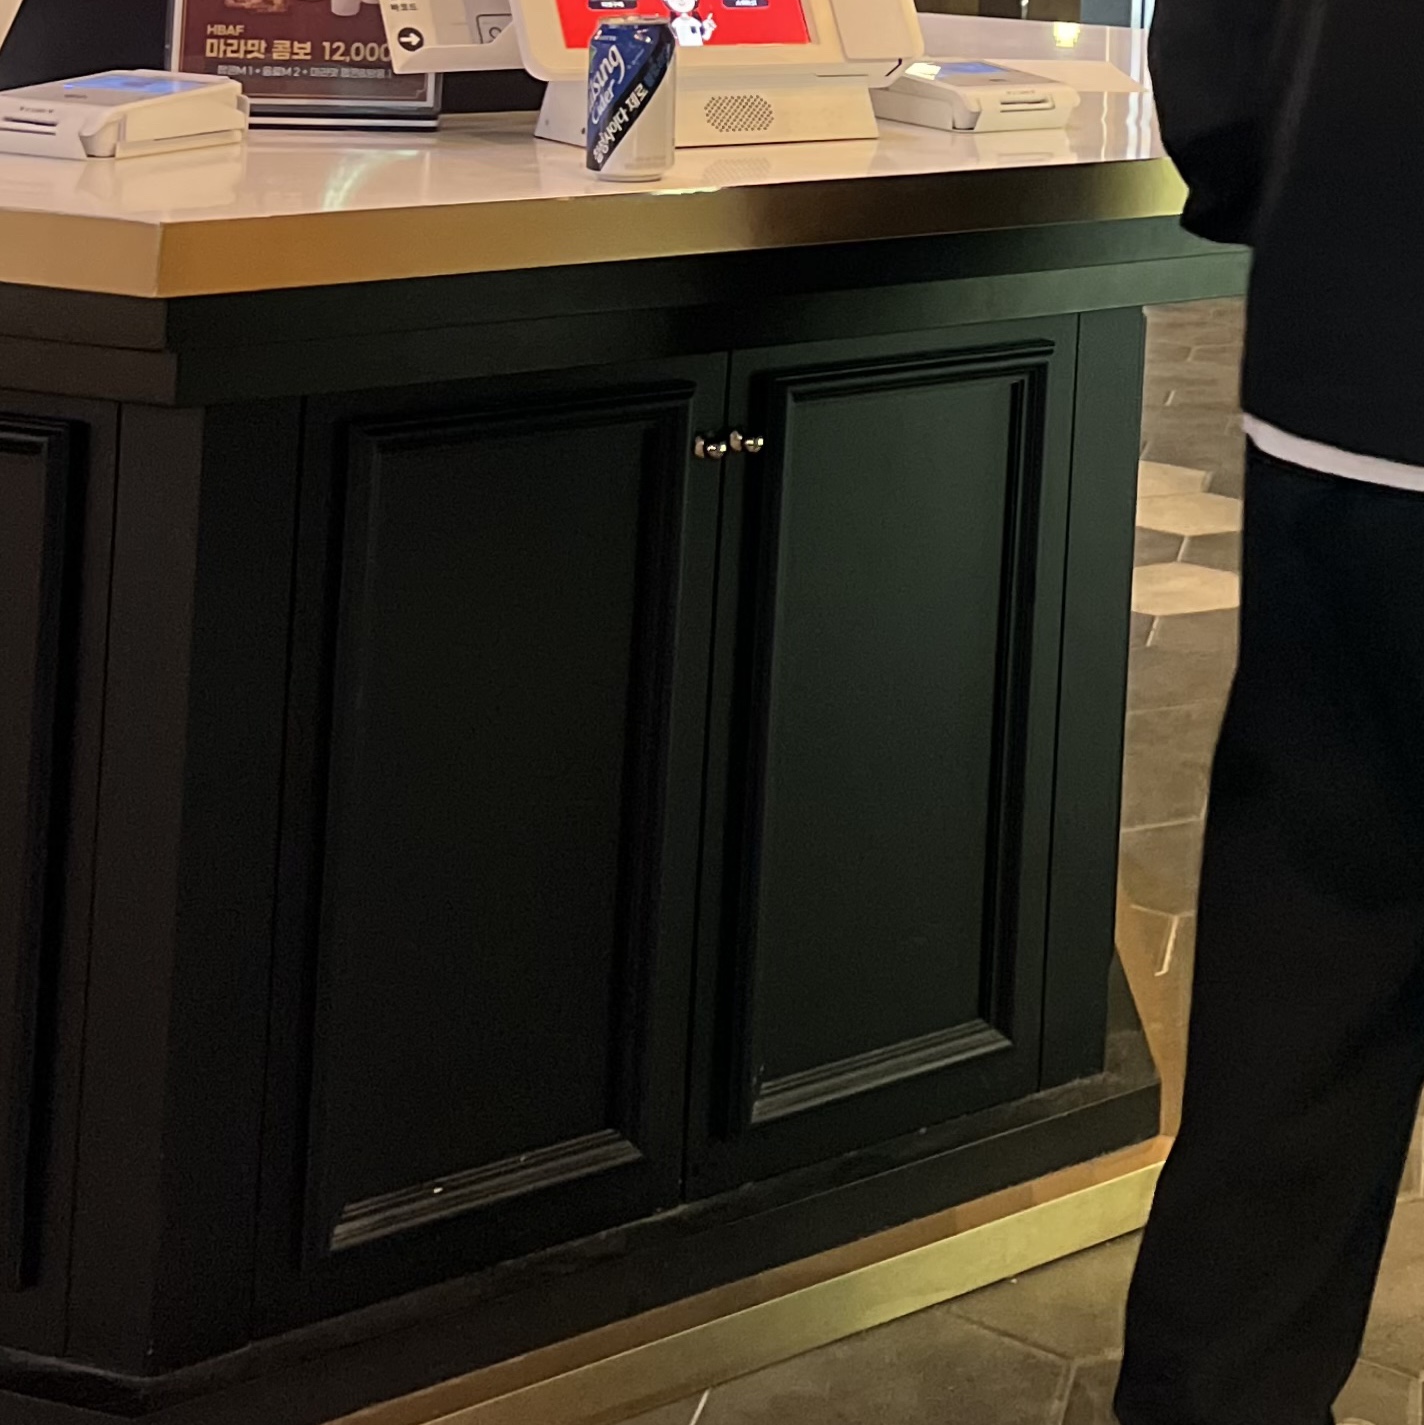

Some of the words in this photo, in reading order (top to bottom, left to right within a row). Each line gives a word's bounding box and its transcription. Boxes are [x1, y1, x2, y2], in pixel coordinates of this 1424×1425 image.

[207, 24, 245, 36] HBAF
[205, 38, 267, 60] 마라맛
[272, 40, 312, 60] 콤보
[322, 41, 391, 62] 12,000
[625, 83, 648, 112] 제로
